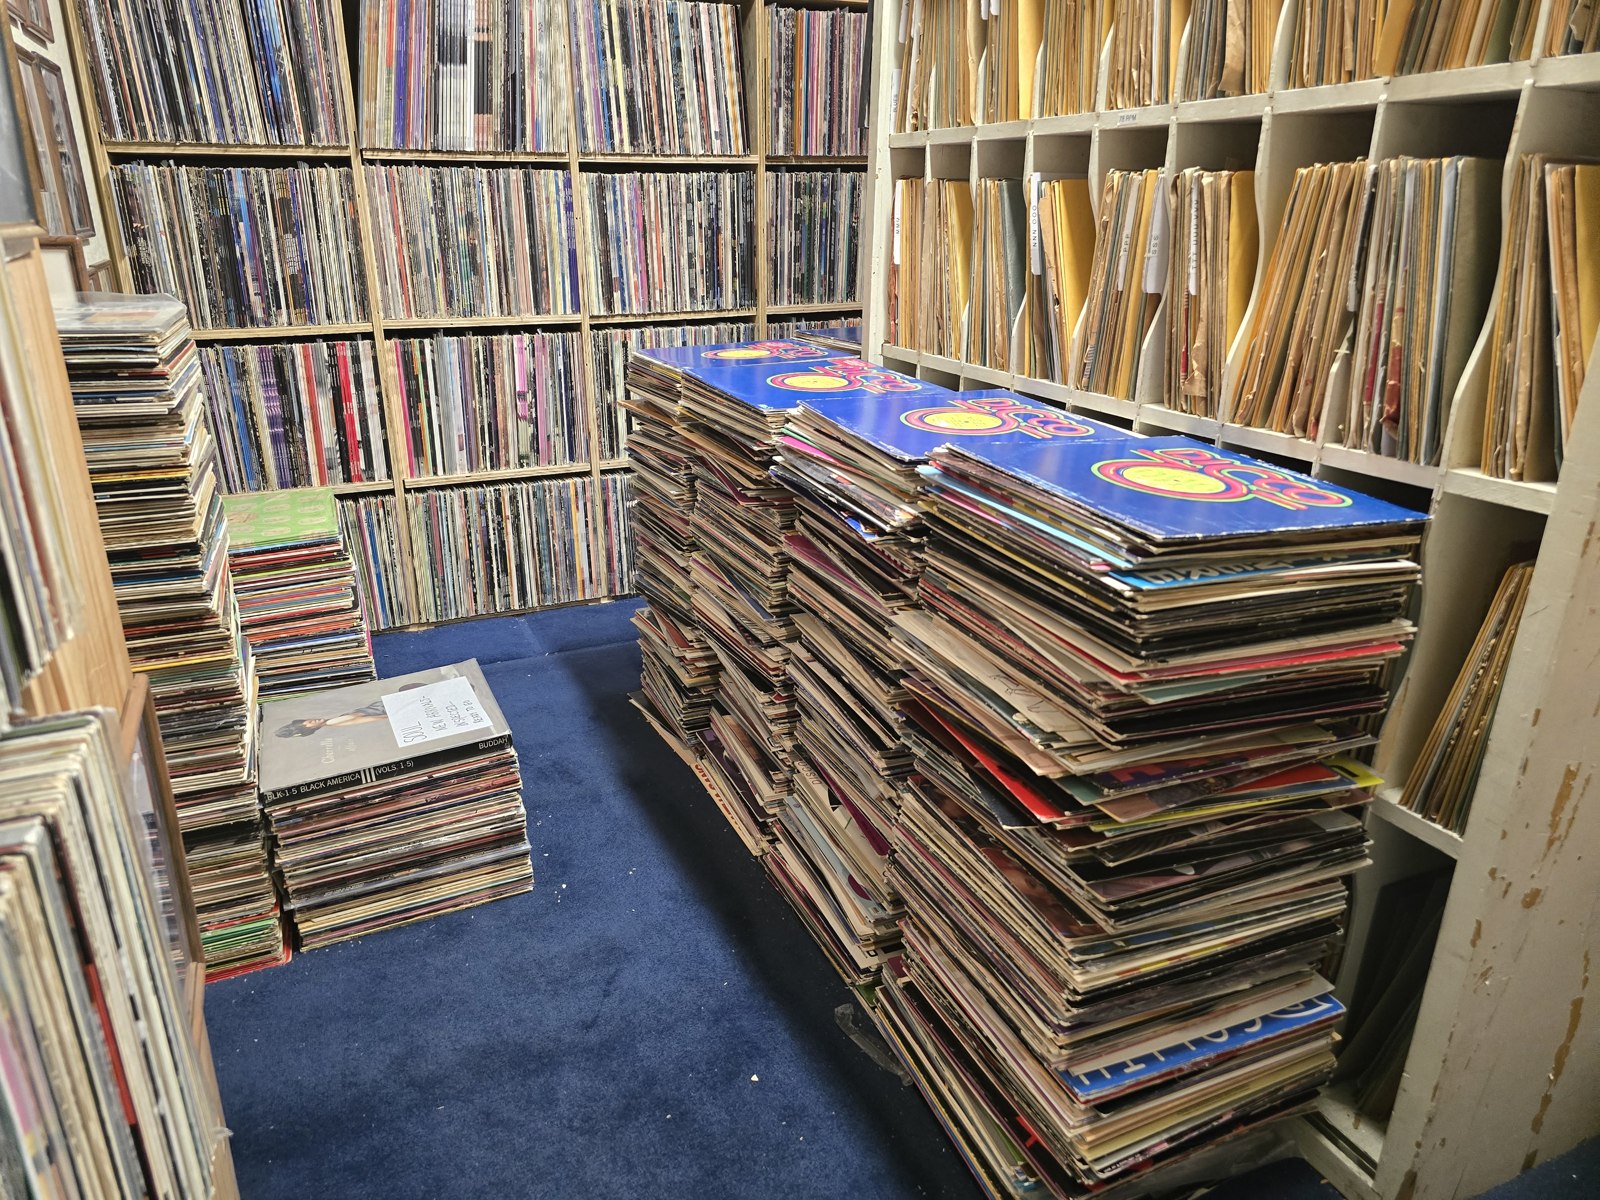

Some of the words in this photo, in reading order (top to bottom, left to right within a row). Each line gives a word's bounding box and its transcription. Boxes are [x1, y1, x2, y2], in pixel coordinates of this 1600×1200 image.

[401, 721, 427, 743] SOUL
[431, 718, 448, 731] NEW
[300, 781, 326, 793] BLACK
[327, 773, 361, 786] AMERICA
[478, 736, 509, 750] BUDDAH
